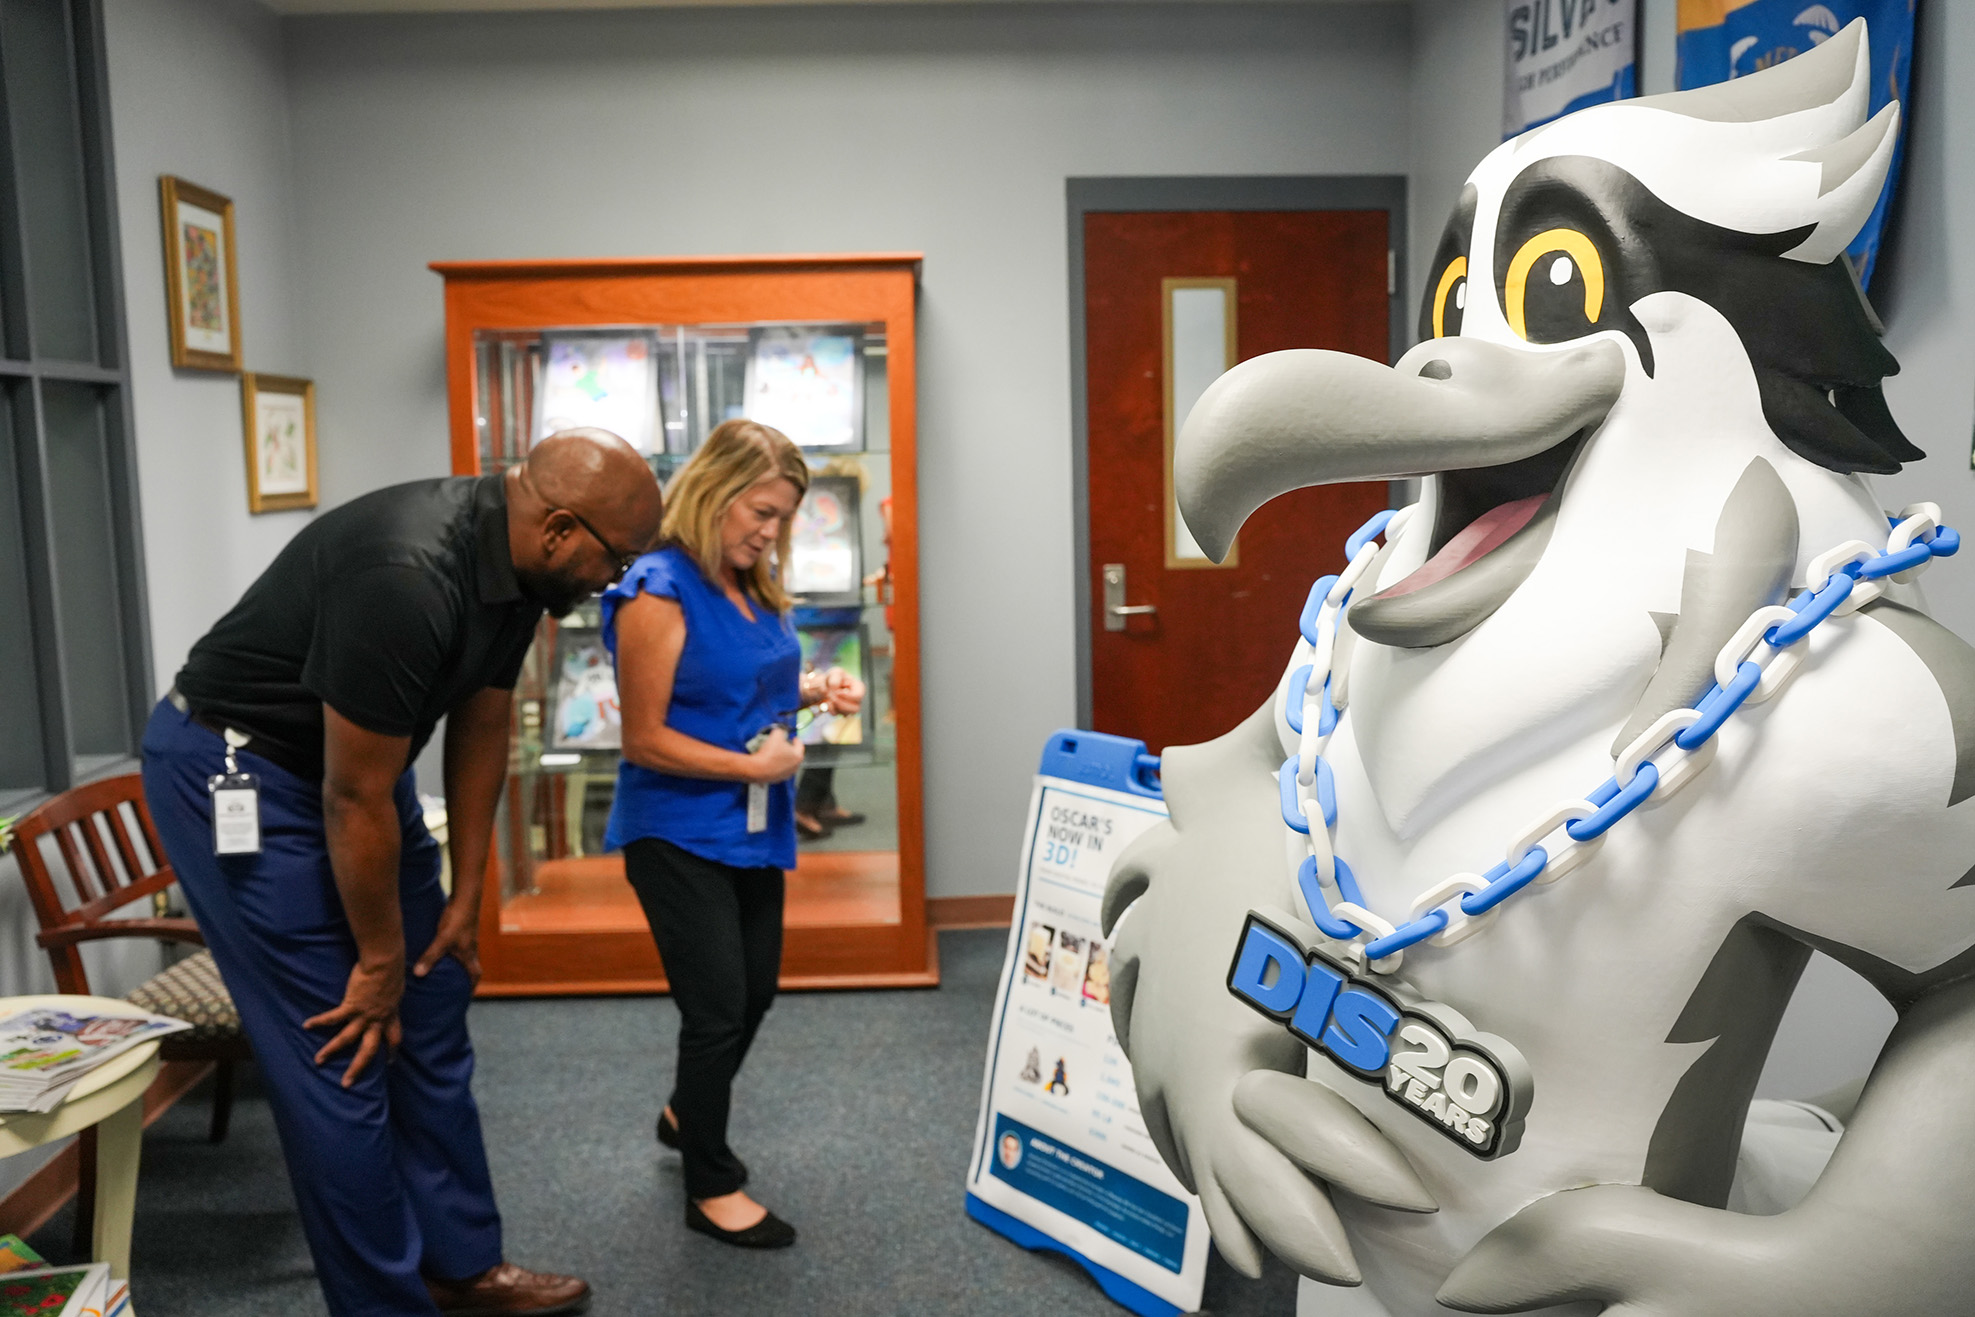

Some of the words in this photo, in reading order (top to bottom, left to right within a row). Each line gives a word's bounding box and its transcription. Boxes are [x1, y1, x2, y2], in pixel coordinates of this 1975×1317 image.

[1051, 806, 1113, 835] OSCAR'S
[1047, 825, 1084, 846] NOW
[1087, 834, 1105, 852] IN
[1042, 841, 1077, 868] 3D!
[1231, 926, 1400, 1071] DIS
[1390, 1024, 1499, 1115] 20
[1389, 1064, 1491, 1145] YEARS
